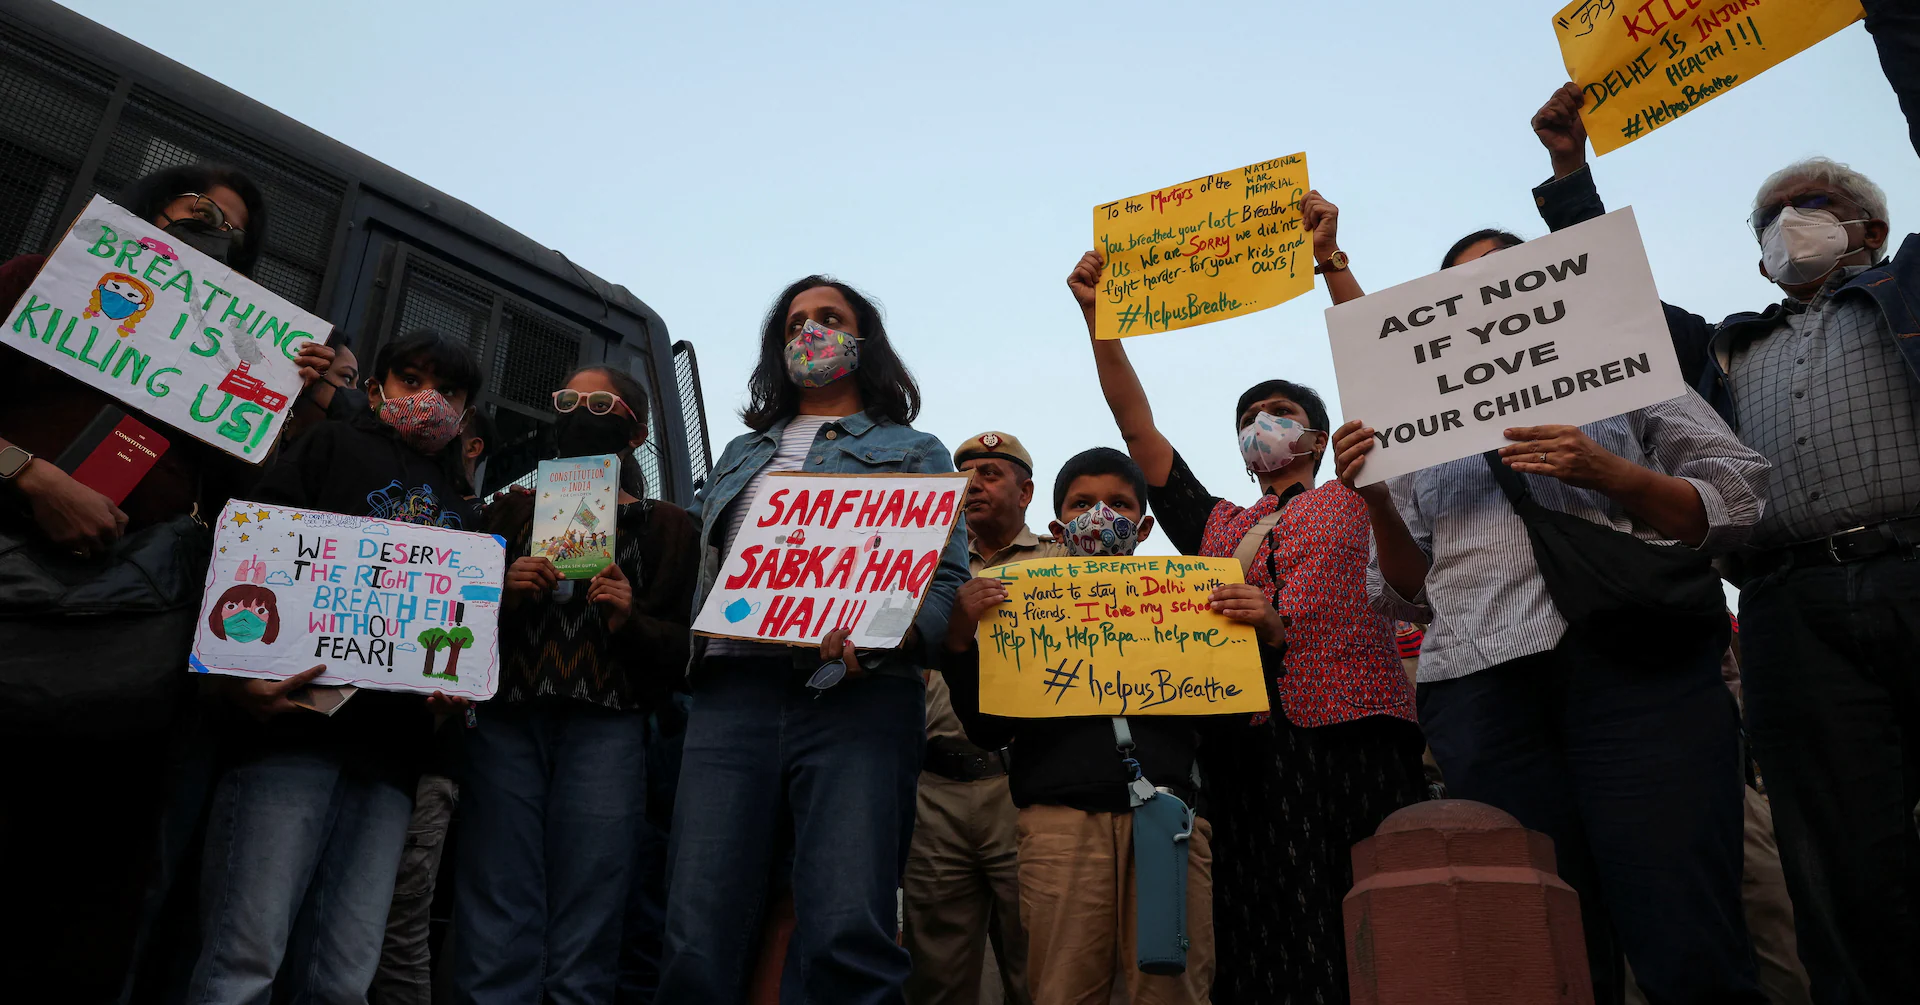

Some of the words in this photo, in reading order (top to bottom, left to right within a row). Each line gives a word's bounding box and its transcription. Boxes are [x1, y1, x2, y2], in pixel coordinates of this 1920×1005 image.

[1582, 46, 1658, 115] DELHI
[1660, 29, 1687, 60] IS
[1244, 156, 1301, 176] NATIONAL
[1247, 173, 1272, 183] WAR
[1101, 201, 1119, 220] To
[1125, 200, 1144, 214] the
[1150, 187, 1194, 215] Martyrs
[1200, 175, 1215, 193] of
[1215, 175, 1232, 190] the
[1100, 234, 1125, 270] You
[1128, 227, 1176, 252] breathed
[1178, 219, 1207, 246] your
[1208, 208, 1239, 230] last
[1241, 200, 1286, 223] Breath
[1287, 187, 1303, 212] fo
[1102, 279, 1141, 304] fight
[1205, 253, 1243, 278] your
[1248, 245, 1275, 260] kids
[1279, 234, 1305, 255] and
[1140, 246, 1160, 271] We
[1164, 246, 1183, 260] are
[1181, 234, 1231, 258] SORRY
[1236, 230, 1252, 241] we
[1252, 251, 1296, 279] ours!
[86, 225, 314, 361] BREATHING
[1378, 294, 1463, 340] ACT
[1479, 252, 1589, 305] NOW
[13, 295, 183, 398] KILLING
[170, 313, 225, 358] IS
[1413, 335, 1453, 365] IF
[1467, 299, 1567, 345] YOU
[1436, 341, 1560, 395] LOVE
[189, 383, 275, 454] US!
[1374, 409, 1465, 449] YOUR
[1473, 352, 1651, 422] CHILDREN
[115, 430, 158, 458] CONSTITUTION
[117, 451, 132, 463] INDIA
[550, 468, 604, 482] CONSTITUTION
[569, 481, 591, 492] INDIA
[298, 534, 338, 560] WE
[357, 538, 461, 569] DESERVE
[990, 563, 1020, 580] I
[1026, 563, 1063, 579] want
[1067, 563, 1082, 578] to
[1083, 561, 1160, 575] BREATHE
[293, 560, 347, 584] THE
[354, 565, 422, 593] RIGHT
[424, 571, 452, 595] TO
[1023, 582, 1063, 601] want
[1066, 582, 1082, 600] to
[1087, 583, 1117, 609] stay
[1126, 581, 1139, 597] in
[1140, 576, 1186, 597] Delhi
[308, 611, 411, 640] WITHOUT
[998, 608, 1018, 628] my
[1023, 602, 1071, 622] friends.
[1074, 602, 1101, 623] I
[1105, 604, 1135, 618] love
[1140, 603, 1163, 625] my
[1170, 598, 1211, 614] schoo
[314, 636, 395, 673] FEAR!
[990, 624, 1025, 673] Help
[1066, 626, 1099, 658] Help
[1154, 625, 1189, 653] help
